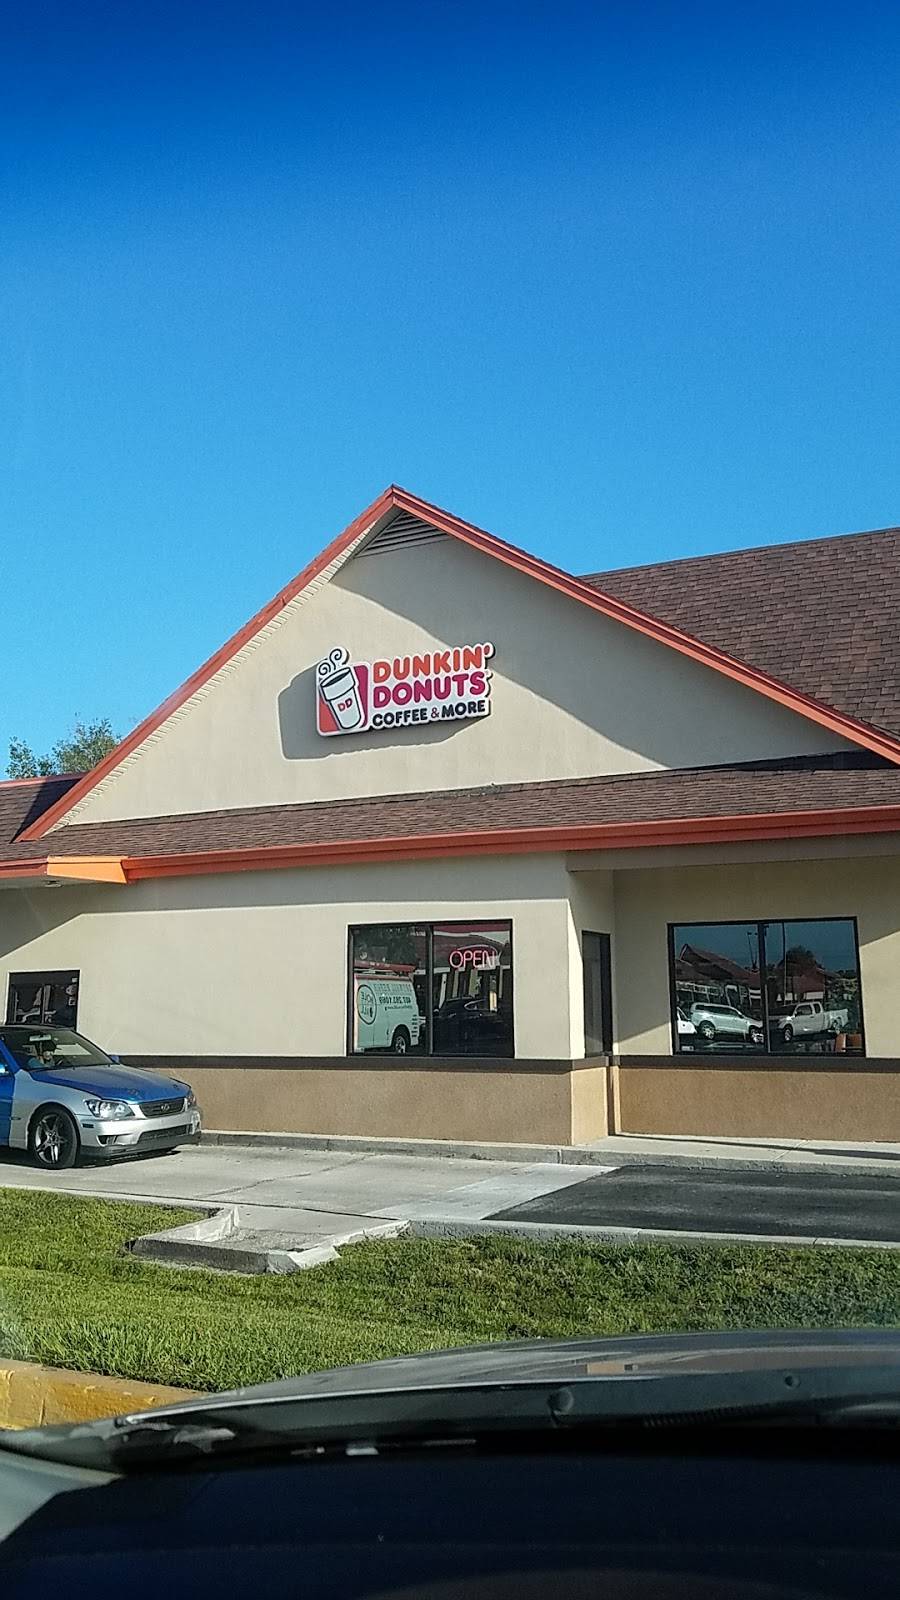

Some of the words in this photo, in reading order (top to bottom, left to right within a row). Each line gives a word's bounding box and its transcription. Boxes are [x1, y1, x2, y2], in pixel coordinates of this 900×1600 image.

[373, 645, 490, 683] DUNKIN'
[373, 671, 486, 708] DONUTS
[337, 698, 353, 712] DD
[372, 708, 427, 727] COFFEE
[441, 700, 486, 718] MORE
[450, 950, 496, 969] OPEN
